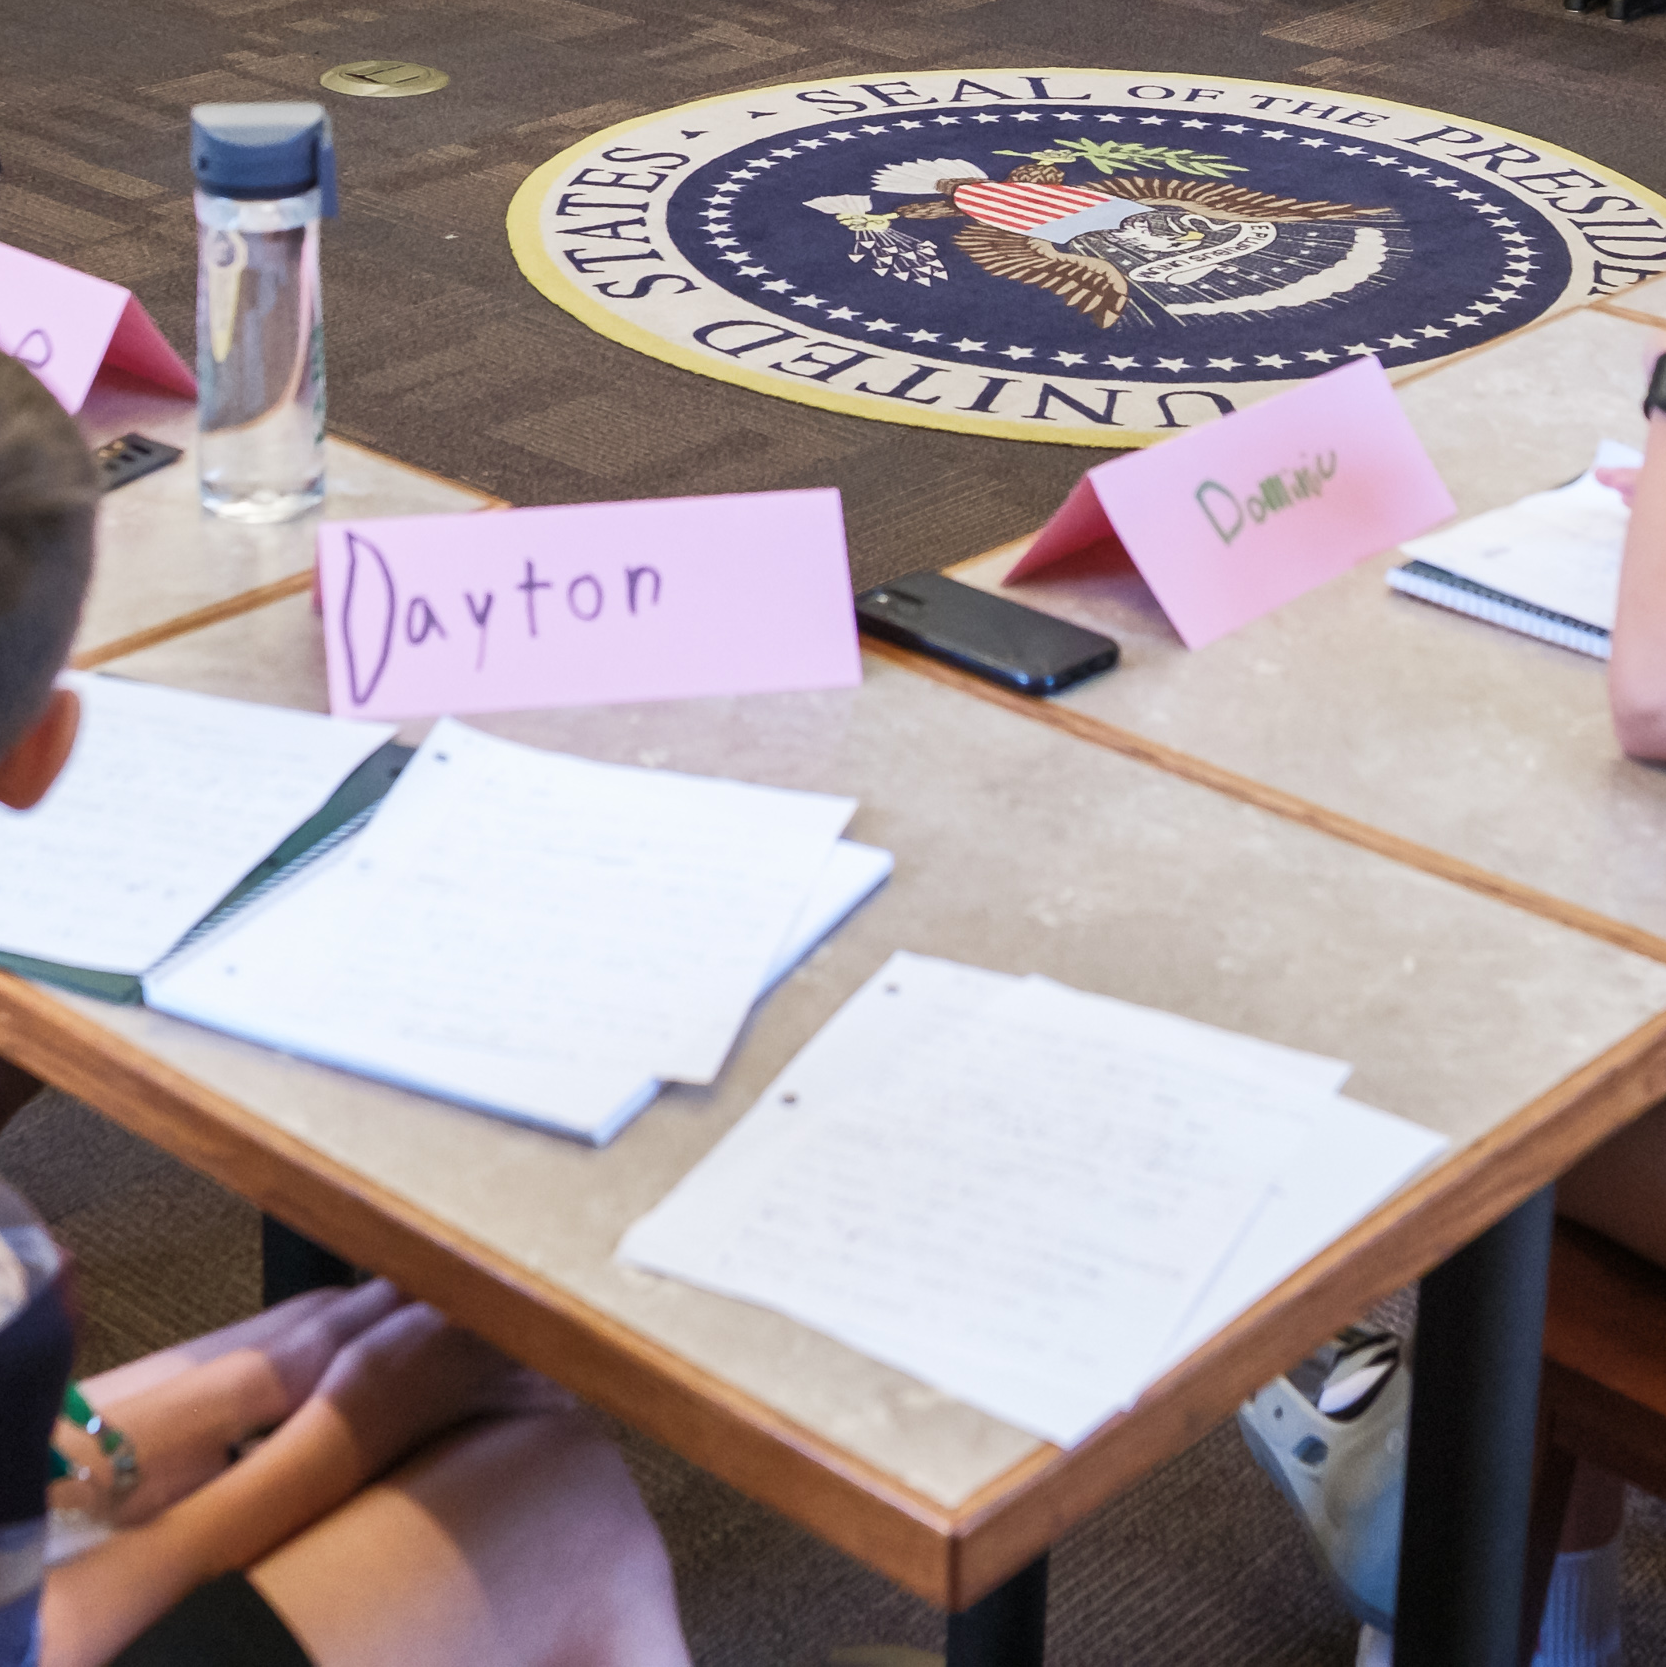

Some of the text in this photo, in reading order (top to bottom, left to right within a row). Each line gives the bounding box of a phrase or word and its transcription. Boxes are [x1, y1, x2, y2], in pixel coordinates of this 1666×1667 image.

[795, 74, 1093, 118] SEAL
[1126, 82, 1223, 107] OF
[1248, 93, 1378, 132] THE
[563, 145, 1237, 429] UNITED STATES
[342, 532, 664, 707] Dayton
